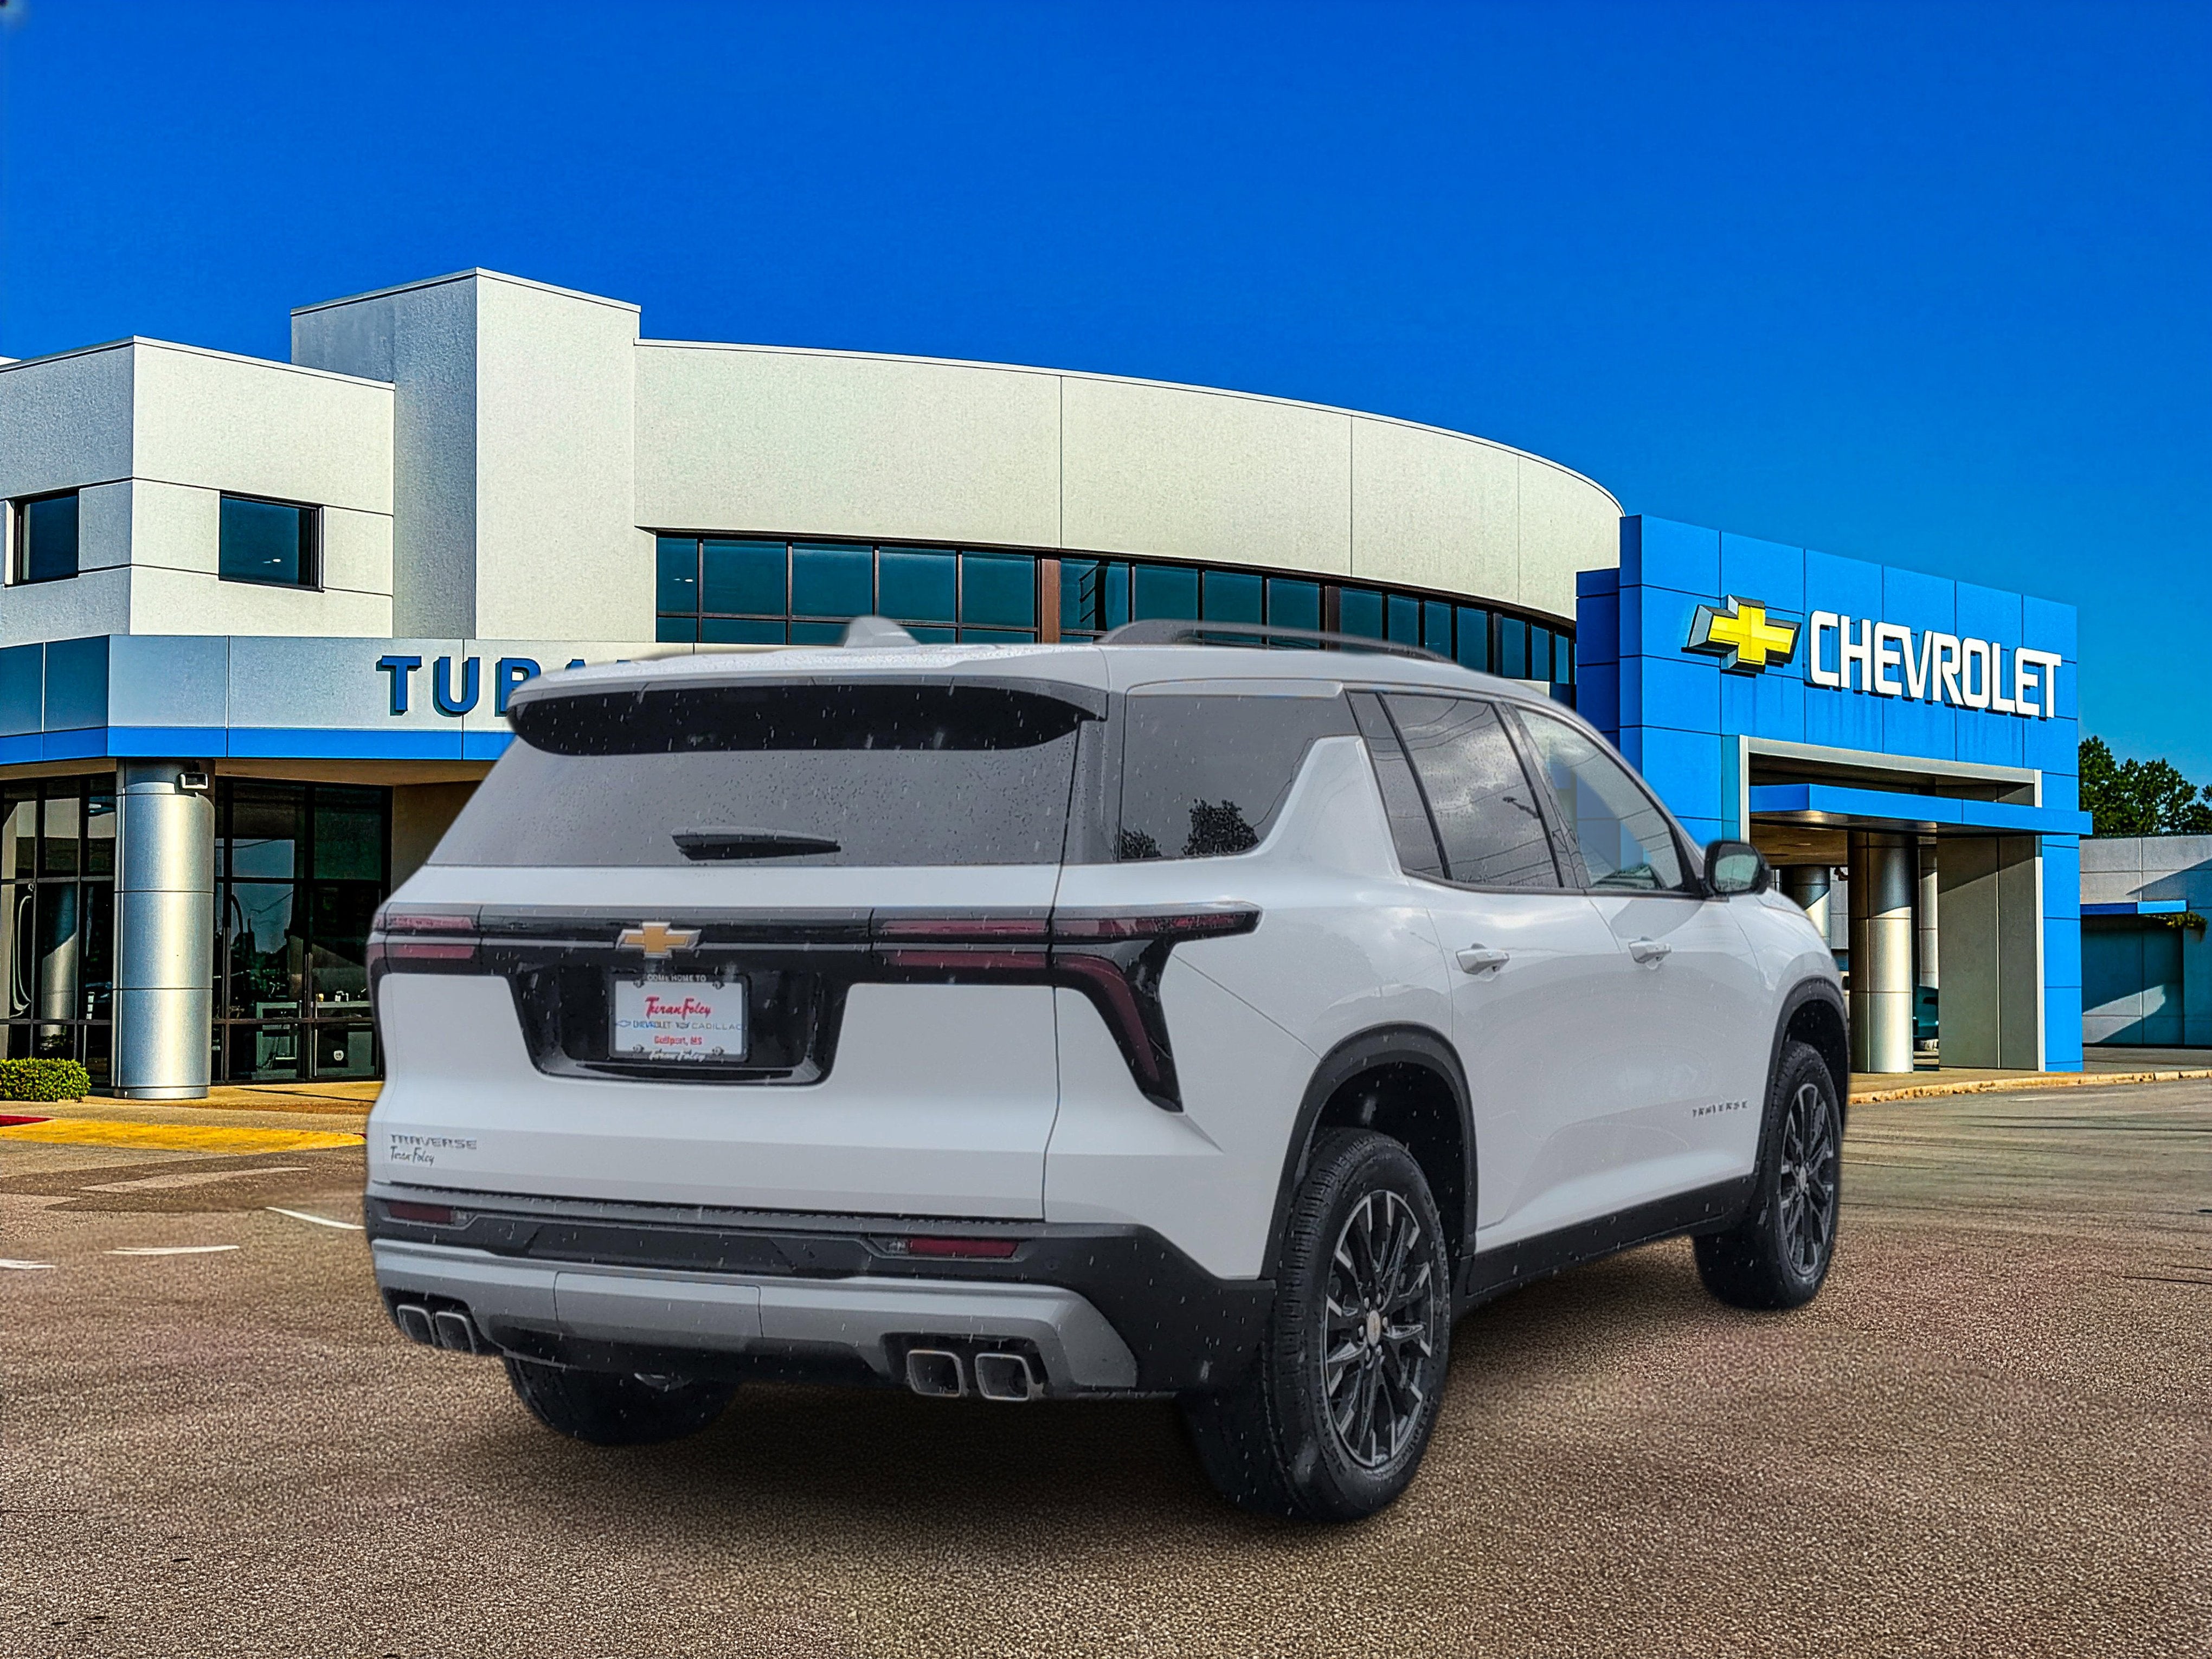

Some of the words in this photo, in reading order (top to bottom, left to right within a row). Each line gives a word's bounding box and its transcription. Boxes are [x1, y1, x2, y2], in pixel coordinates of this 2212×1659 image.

[1809, 610, 2062, 718] CHEVROLET
[376, 655, 631, 717] TUR
[691, 1022, 742, 1031] CADILLAC
[690, 1036, 703, 1045] MS
[1692, 1100, 1747, 1117] TRAVERSE
[391, 1134, 477, 1150] TRAVERSE
